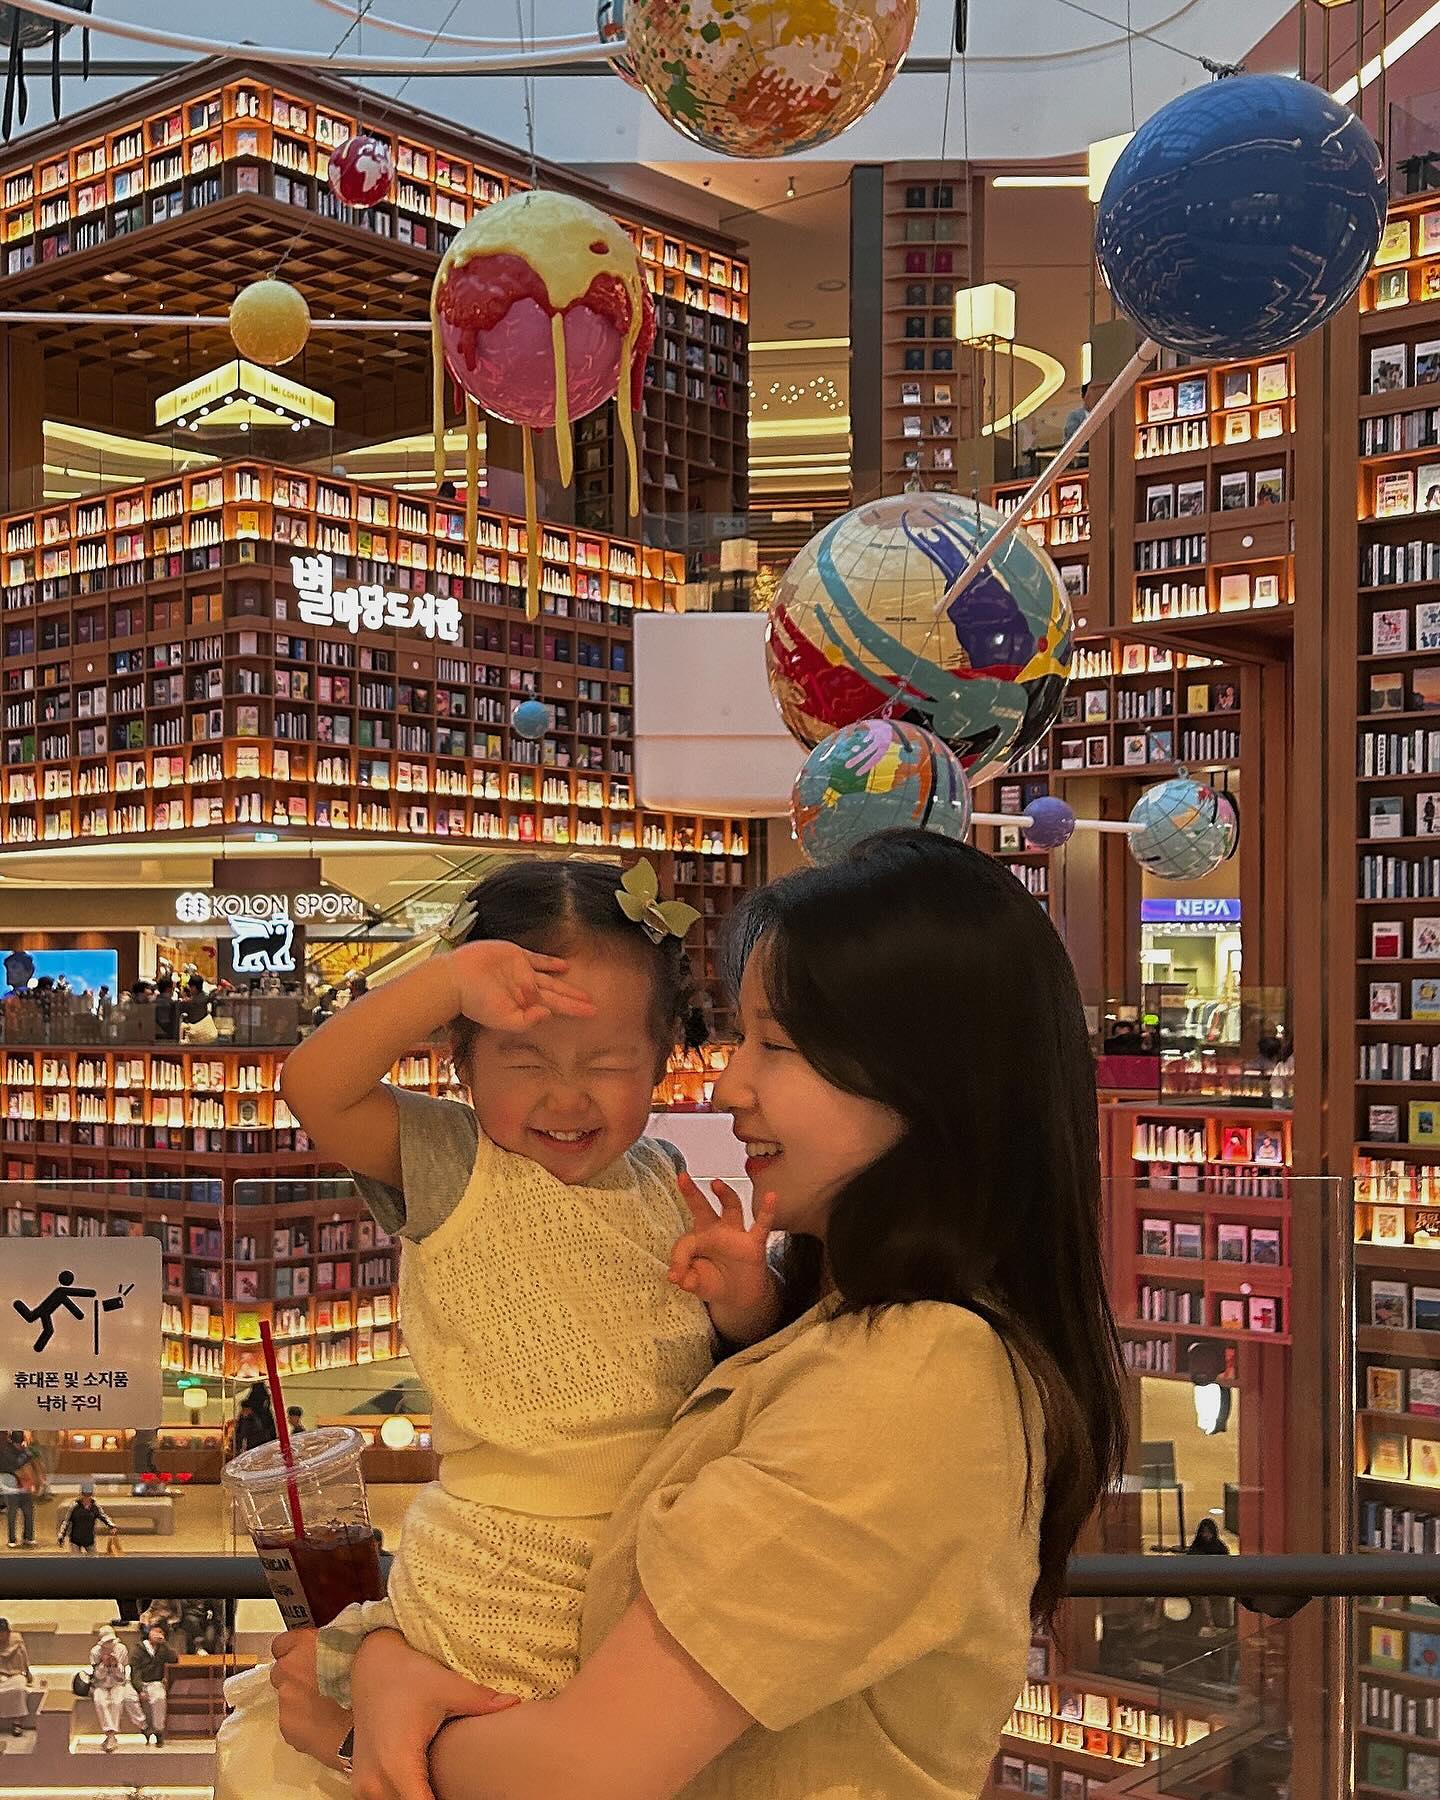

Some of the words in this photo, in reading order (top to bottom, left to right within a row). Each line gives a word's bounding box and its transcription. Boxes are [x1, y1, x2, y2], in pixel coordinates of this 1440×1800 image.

[290, 553, 462, 641] 별마당도서관
[211, 894, 288, 918] KOLON
[1175, 899, 1230, 916] NEPA
[14, 1371, 59, 1389] 휴대폰
[64, 1371, 79, 1389] 및
[83, 1371, 129, 1389] 소지품
[37, 1394, 68, 1412] 낙하
[71, 1394, 102, 1412] 주의
